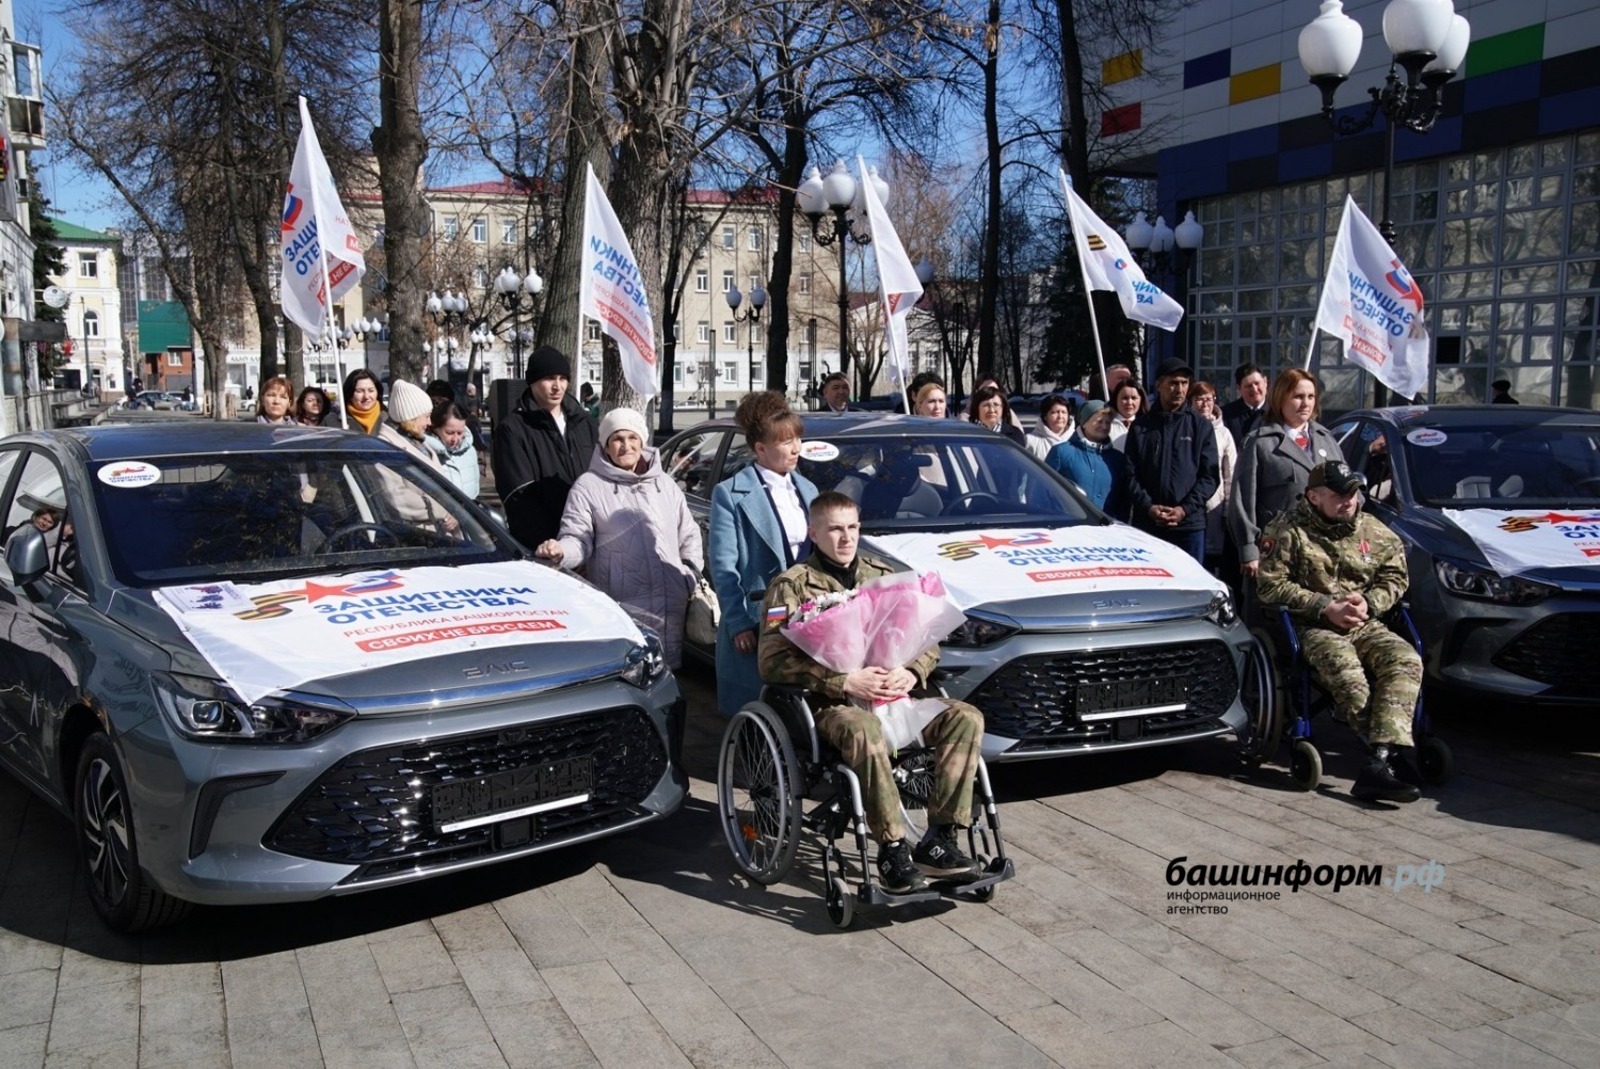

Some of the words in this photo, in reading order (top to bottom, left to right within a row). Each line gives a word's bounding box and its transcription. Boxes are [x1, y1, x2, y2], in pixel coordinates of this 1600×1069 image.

[295, 241, 320, 275] ОТЕ
[994, 546, 1152, 557] ЗАЩИТНИКИ
[1008, 554, 1150, 566] ОТЕЧЕСТВА
[1035, 570, 1083, 580] СВОИХ
[313, 587, 538, 613] ЗАЩИТНИКИ
[327, 597, 531, 624] ОТЕЧЕСТВА
[344, 616, 451, 638] РЕСПУБЛИКА
[452, 609, 570, 621] БАШКОРТОСТАН
[367, 630, 440, 650] СВОИХ
[438, 627, 466, 639] НЕ
[466, 620, 557, 635] БРОСАЕМ
